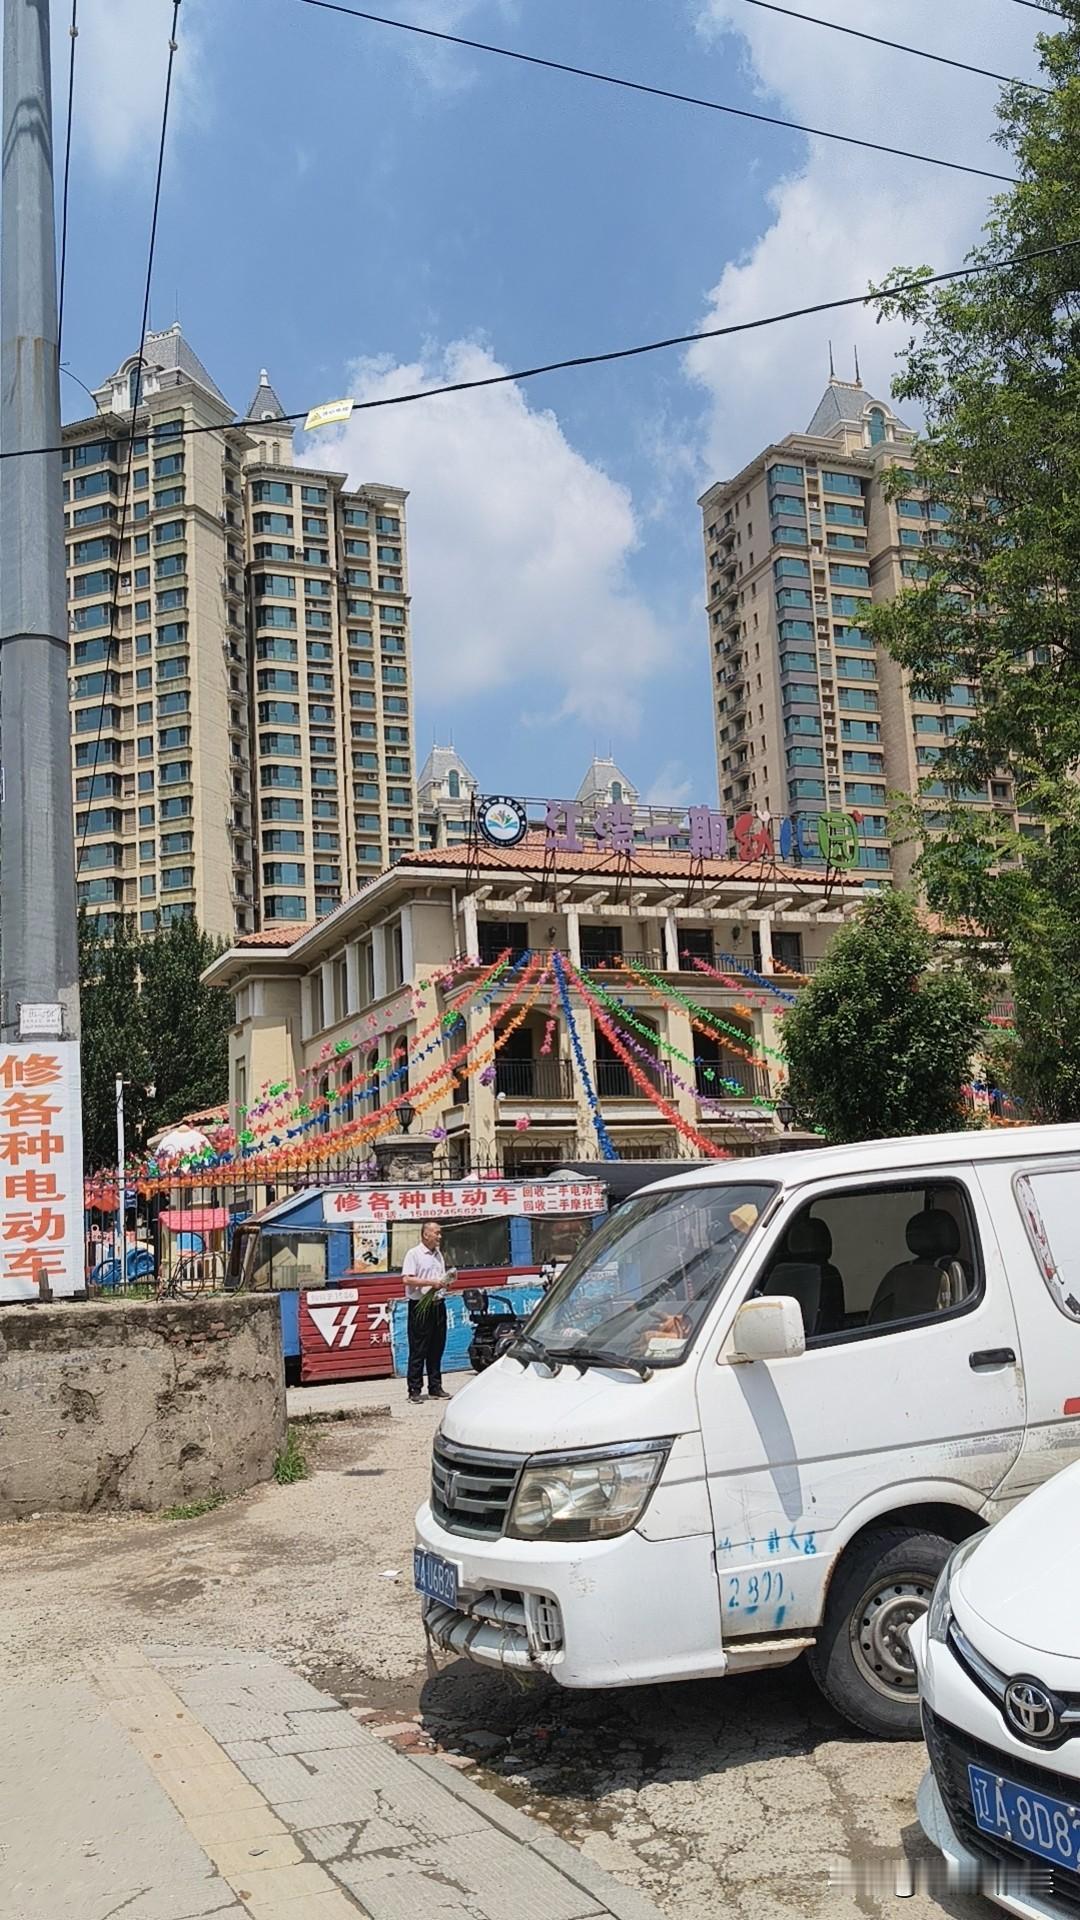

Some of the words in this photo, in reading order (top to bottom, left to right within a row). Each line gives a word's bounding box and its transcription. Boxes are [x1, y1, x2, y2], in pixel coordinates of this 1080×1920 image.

[545, 799, 860, 868] 江湾一期幼儿园
[0, 1053, 66, 1283] 修各种电动车
[334, 1187, 517, 1213] 修各种电动车
[522, 1184, 605, 1198] 回收二手电动车
[523, 1199, 605, 1212] 回收二手摩托车
